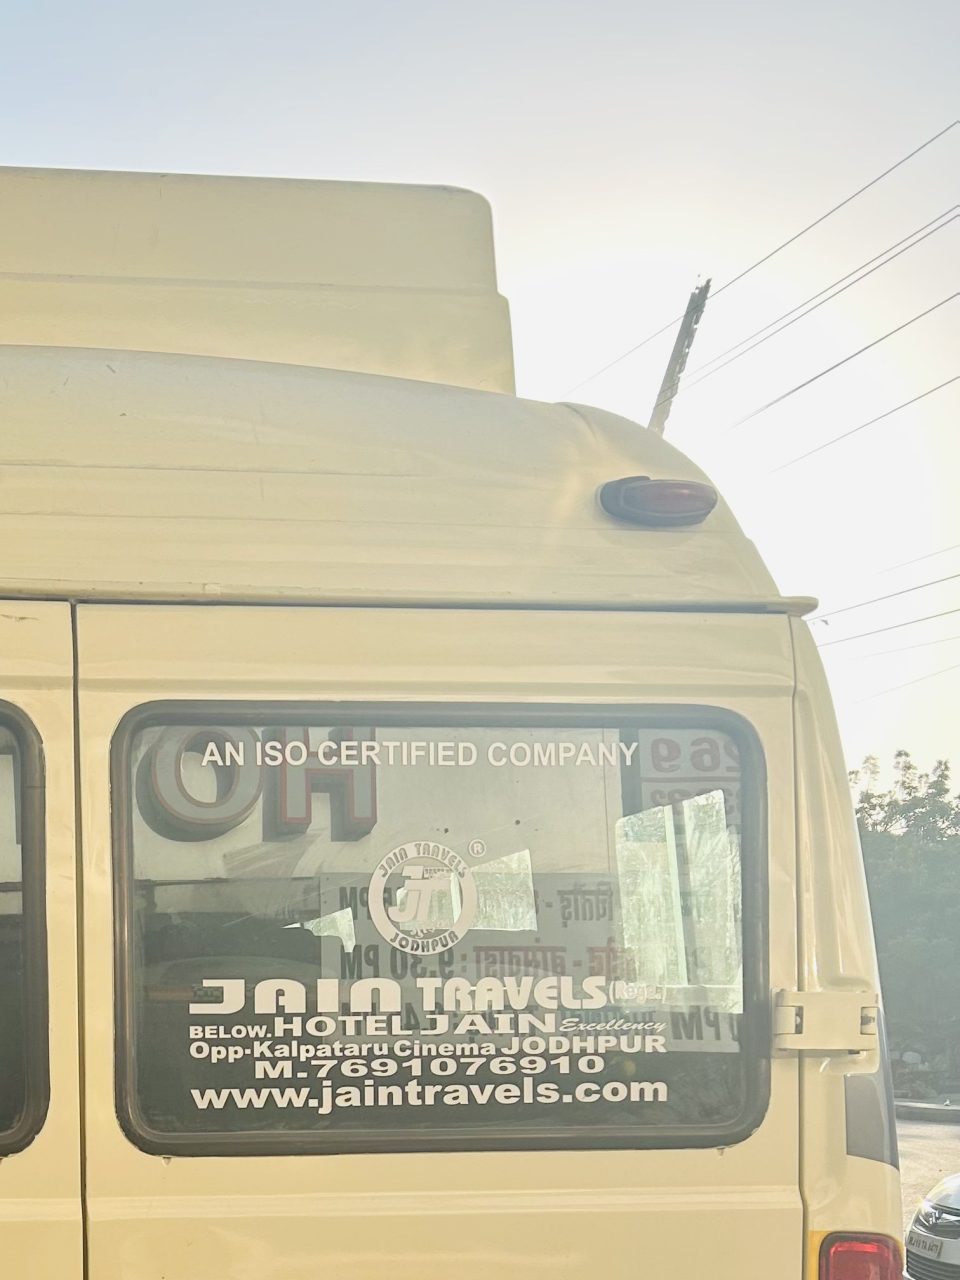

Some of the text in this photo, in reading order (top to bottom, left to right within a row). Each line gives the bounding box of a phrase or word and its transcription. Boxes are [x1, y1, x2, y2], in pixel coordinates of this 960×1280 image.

[201, 741, 638, 768] AN ISO CERTIFIED COMPANY
[378, 846, 409, 879] JAIN
[389, 930, 460, 953] JODHPUR
[189, 978, 404, 1014] JAIN
[416, 975, 608, 1011] TRAVELS
[189, 1013, 668, 1039] BELOW. HOTEL JAIN Excellency
[393, 1040, 496, 1057] Cinema
[501, 1034, 667, 1055] JODHPUR
[253, 1054, 605, 1079] M.7691076910
[190, 1076, 668, 1115] www.jaintravels.com
